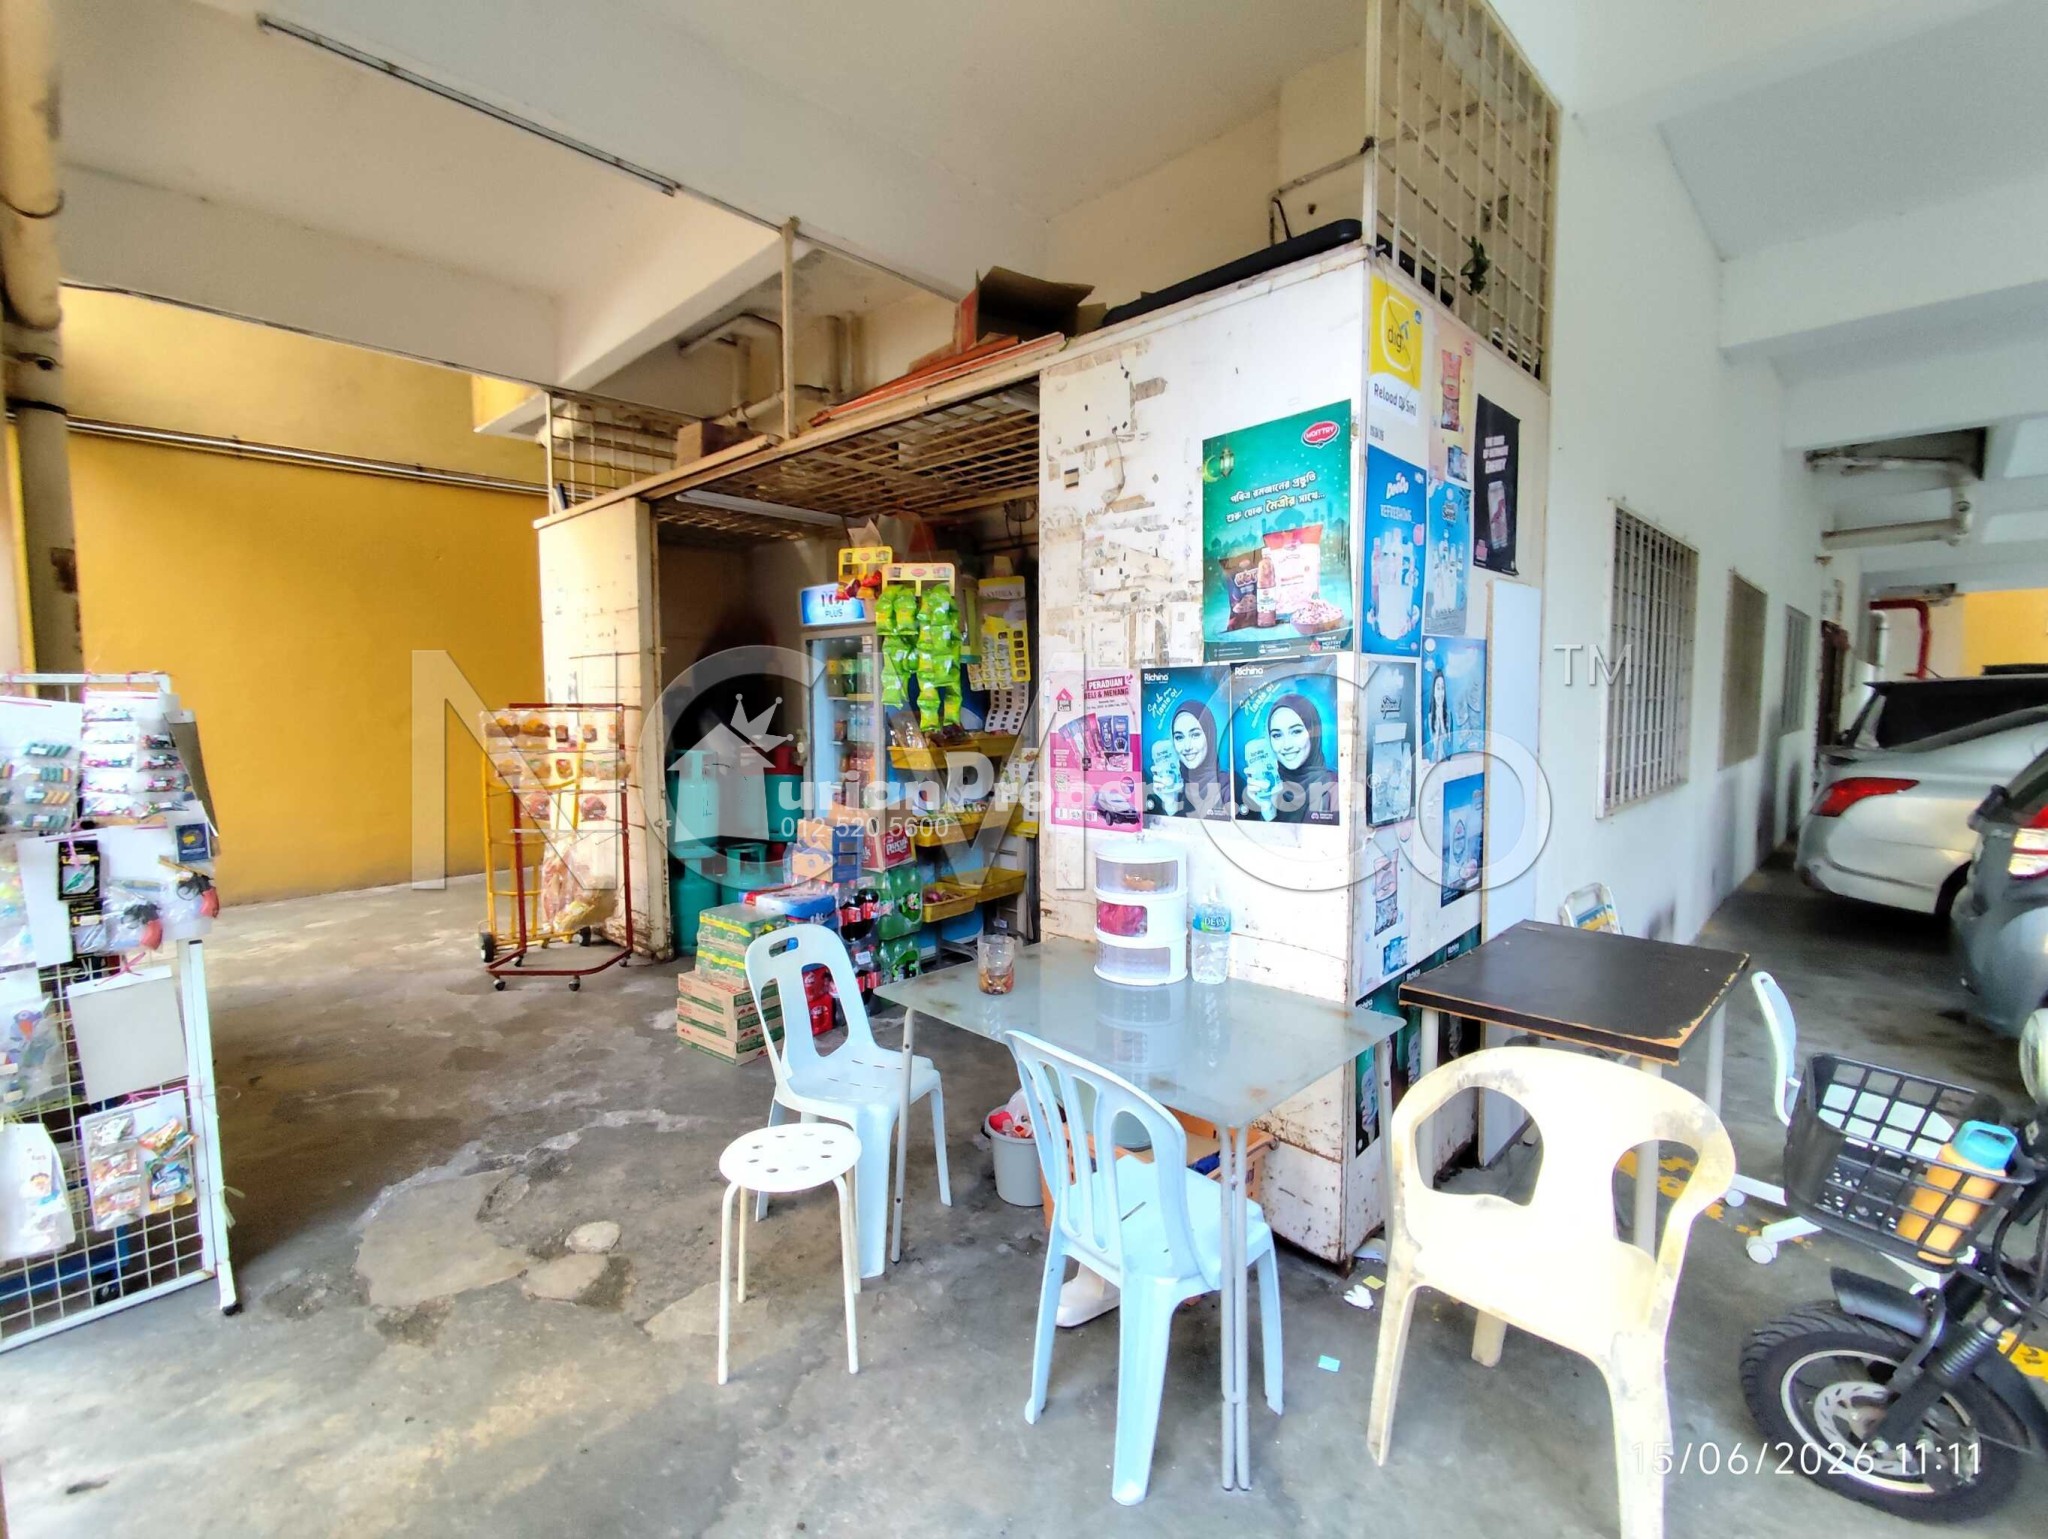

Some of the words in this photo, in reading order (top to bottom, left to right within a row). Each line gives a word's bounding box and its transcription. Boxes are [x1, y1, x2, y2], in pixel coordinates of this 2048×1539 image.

[1374, 383, 1398, 406] Reload
[824, 608, 844, 618] PLUS
[1235, 667, 1264, 676] Richino
[1144, 673, 1169, 681] Richino
[1088, 678, 1123, 690] PERADUAN
[1098, 691, 1102, 699] &
[1103, 688, 1129, 697] MENANG
